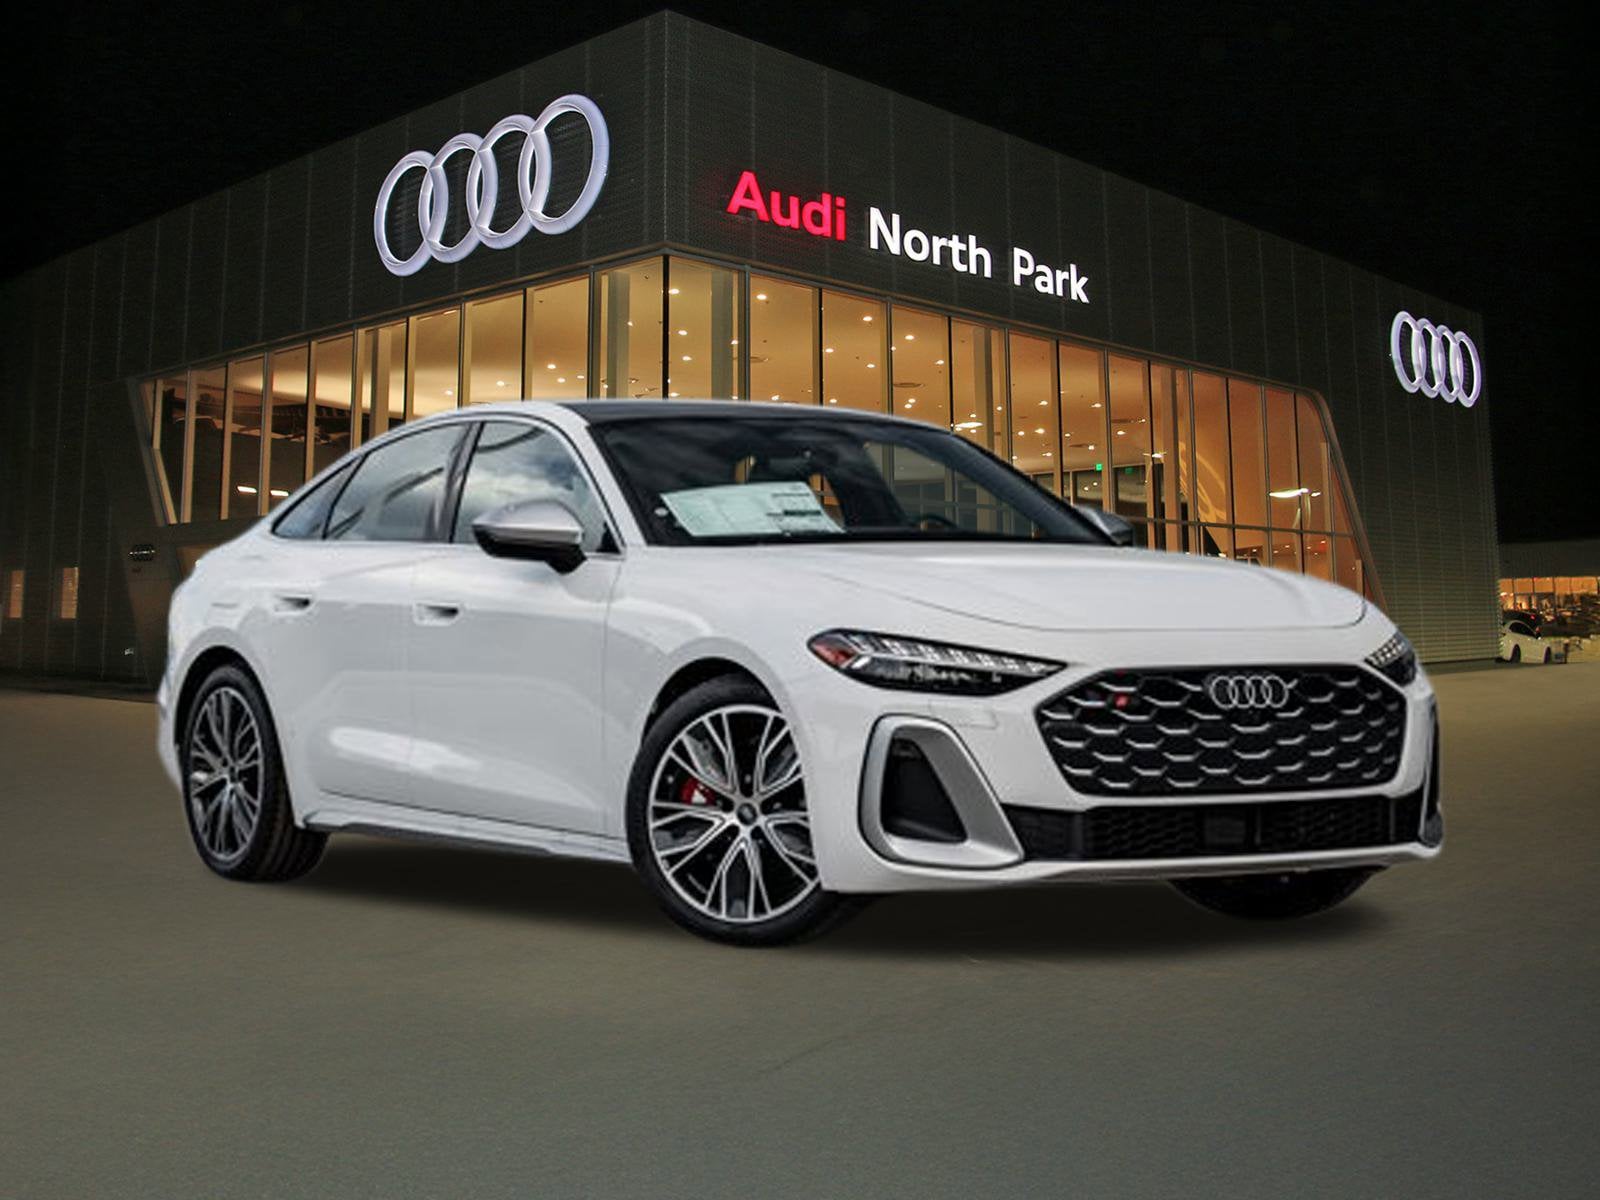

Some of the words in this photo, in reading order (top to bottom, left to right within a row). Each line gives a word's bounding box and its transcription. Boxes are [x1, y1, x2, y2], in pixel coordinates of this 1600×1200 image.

[727, 171, 846, 240] Audi
[870, 207, 991, 277] North
[1014, 247, 1089, 303] Park
